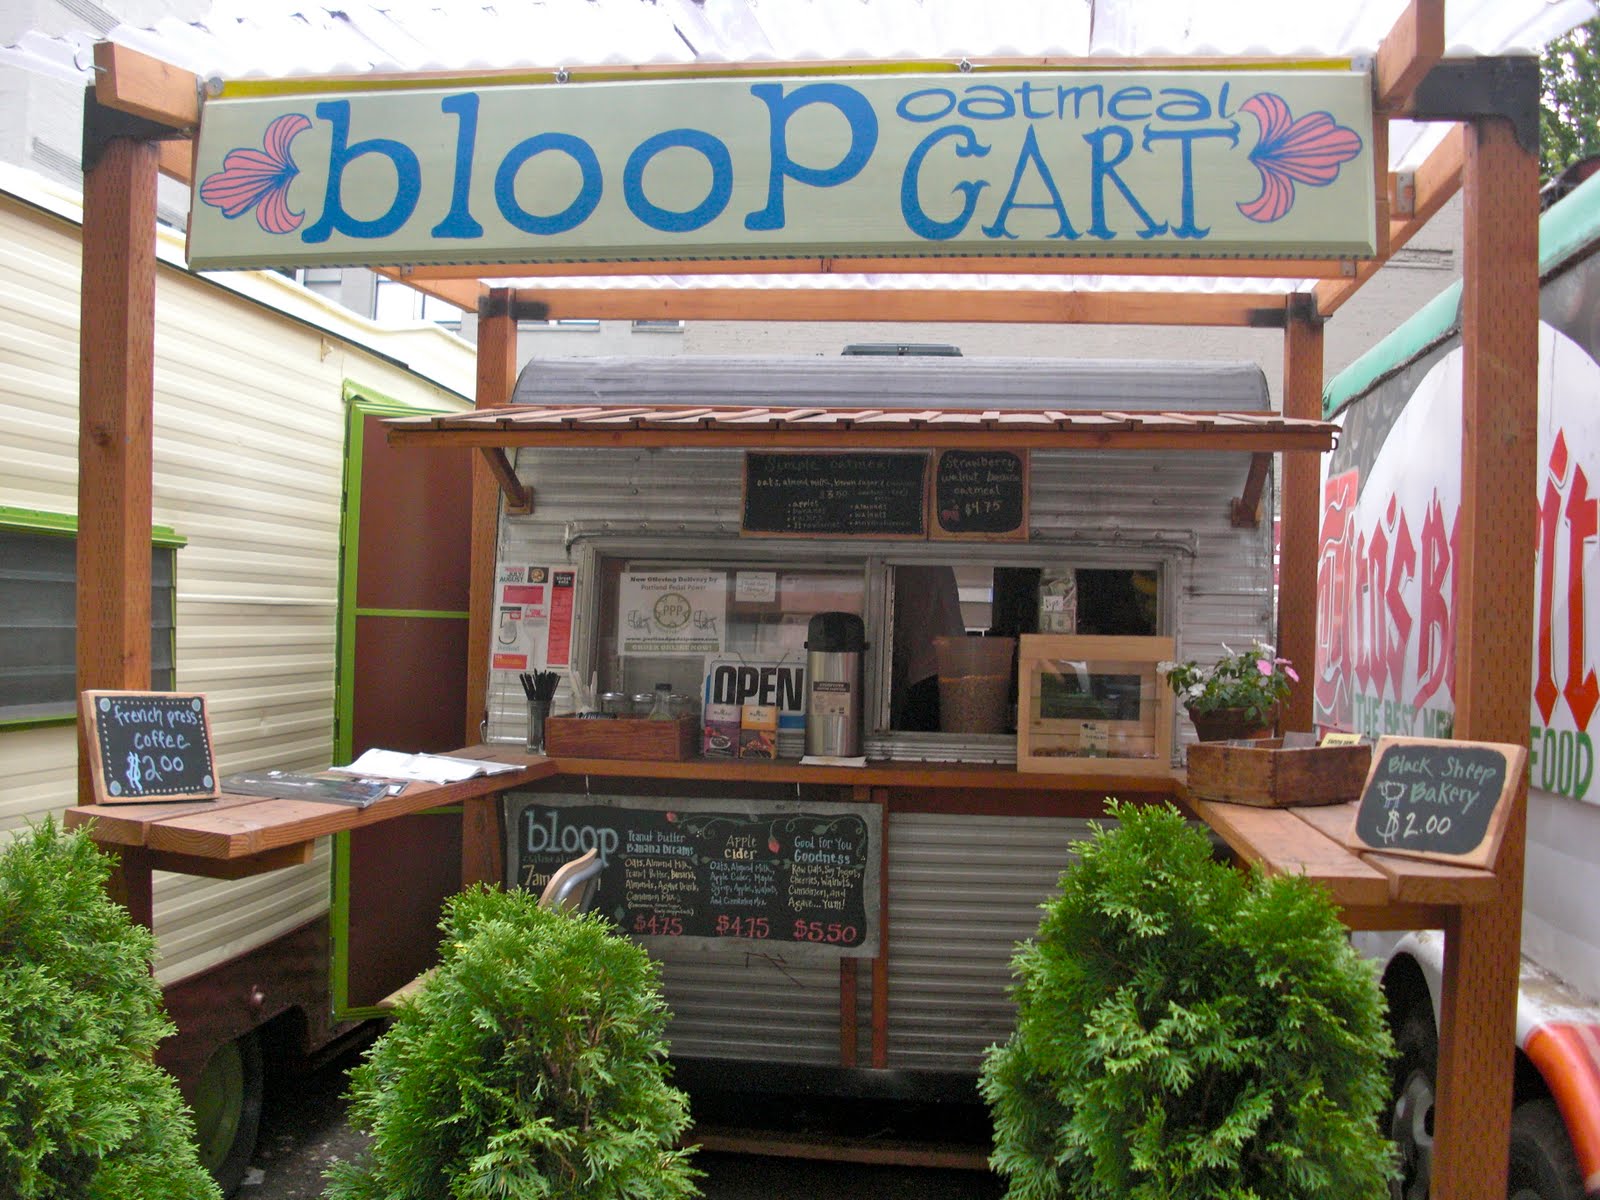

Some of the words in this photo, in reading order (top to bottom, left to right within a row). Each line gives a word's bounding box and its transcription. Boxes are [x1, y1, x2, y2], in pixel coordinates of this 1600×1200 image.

[896, 82, 1239, 122] oatmeal
[301, 82, 879, 243] bloop
[678, 576, 707, 584] Delivery
[713, 665, 804, 711] OPEN
[114, 704, 164, 727] french
[167, 708, 198, 728] press
[134, 729, 191, 750] coffee
[1388, 754, 1434, 777] Black
[1440, 755, 1496, 785] Sheep
[1410, 783, 1480, 814] Bakery
[627, 830, 653, 842] Peanut
[657, 831, 686, 843] Butter
[1376, 808, 1451, 843] $2.00
[525, 810, 619, 868] bloop
[626, 843, 660, 854] Banana
[662, 844, 694, 856] Dreams
[794, 836, 815, 848] Good
[819, 837, 833, 849] For
[835, 838, 852, 850] You
[794, 849, 851, 865] Goodness
[822, 898, 846, 910] Yum!
[793, 918, 858, 943] $5.50
